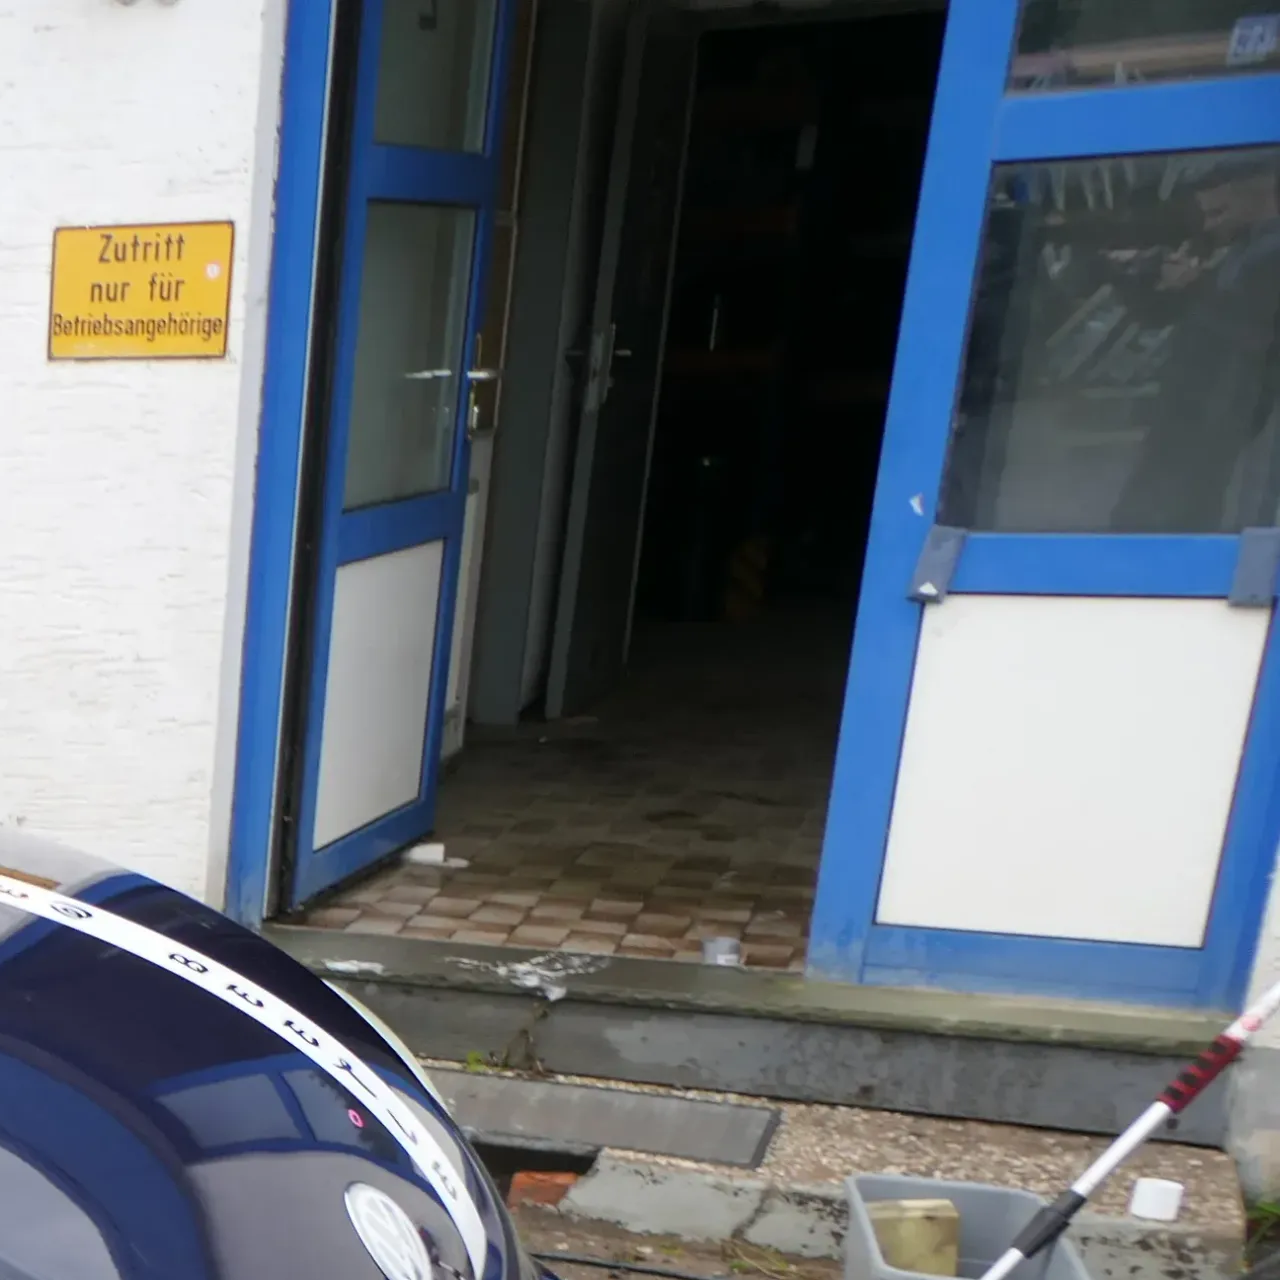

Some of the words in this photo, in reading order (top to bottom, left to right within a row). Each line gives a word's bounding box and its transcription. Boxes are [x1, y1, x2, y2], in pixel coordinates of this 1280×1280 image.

[97, 232, 186, 264] Zutritt
[90, 281, 131, 303] nur
[148, 272, 186, 302] für
[52, 312, 223, 342] Betriebsangehörige
[168, 951, 458, 1201] BEETLE
